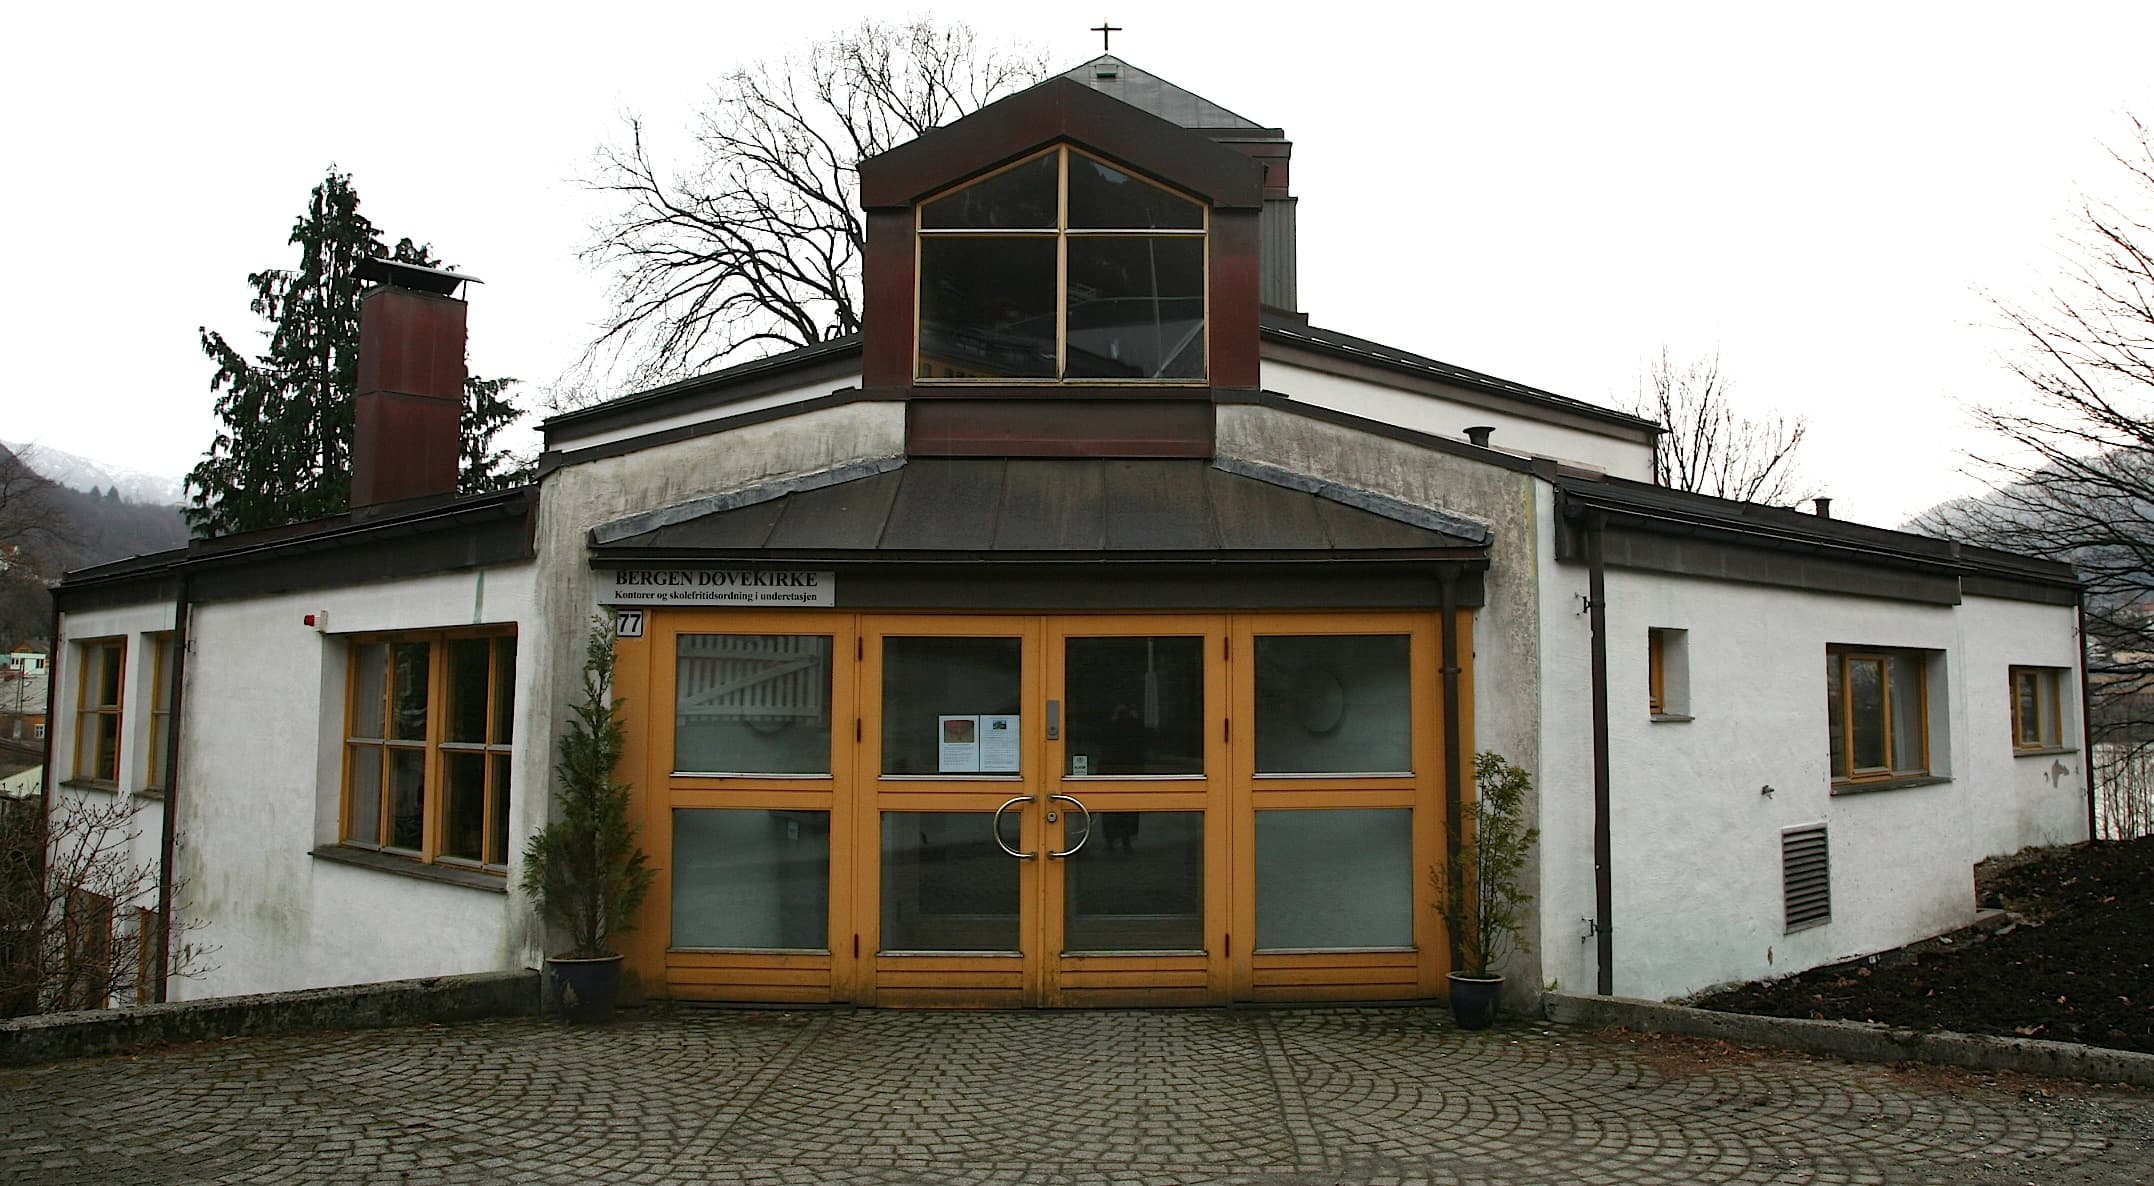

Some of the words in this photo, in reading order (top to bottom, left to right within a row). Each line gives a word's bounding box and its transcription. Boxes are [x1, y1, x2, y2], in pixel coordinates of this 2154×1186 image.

[616, 571, 693, 586] BERGEN
[698, 571, 818, 587] DØVEKIRKE
[615, 590, 654, 599] Kontorer
[656, 592, 668, 601] og
[669, 590, 753, 602] skolefritidsordning
[760, 591, 817, 602] underetasjen
[619, 614, 641, 633] 77
